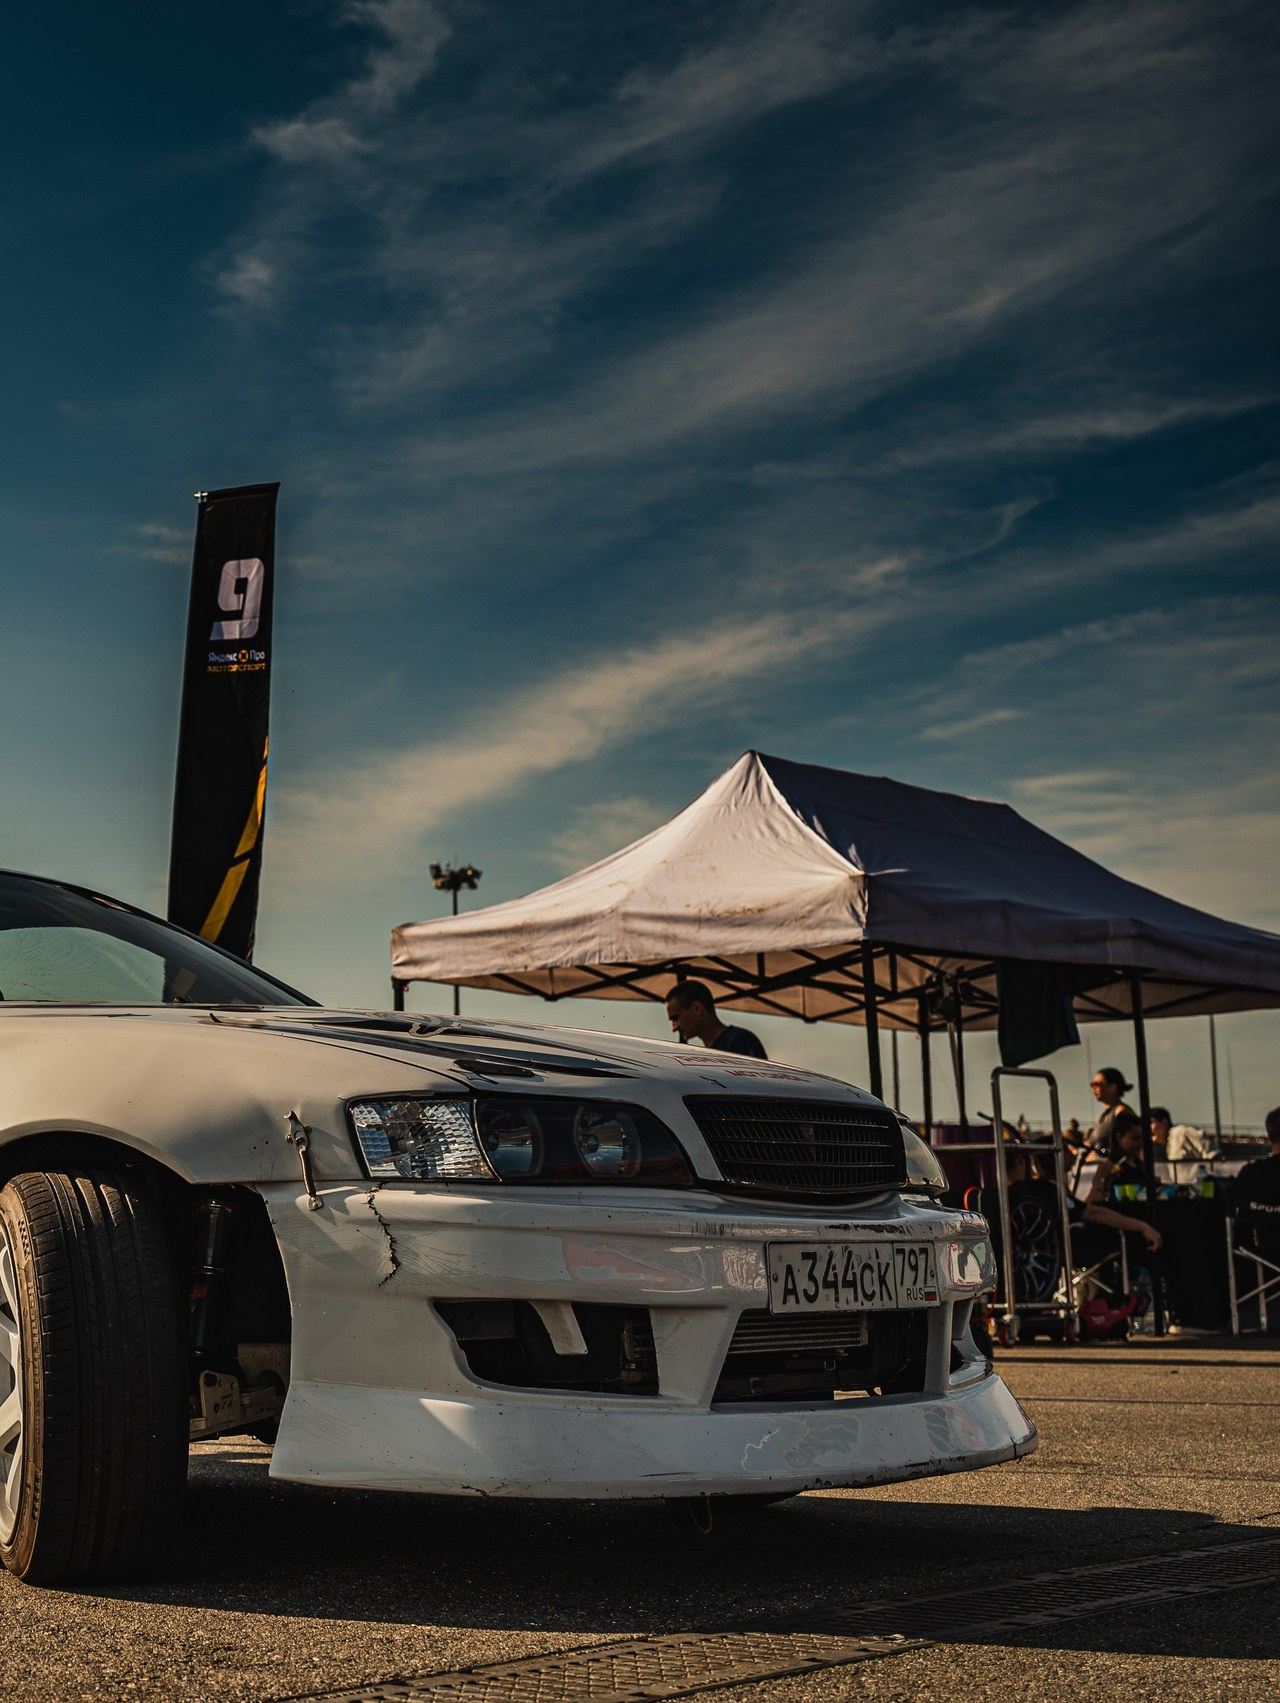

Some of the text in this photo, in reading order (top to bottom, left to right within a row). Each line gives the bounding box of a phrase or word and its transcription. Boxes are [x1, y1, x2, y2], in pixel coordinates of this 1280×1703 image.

[210, 558, 265, 641] 9
[208, 649, 266, 663] Яндекс Про
[895, 1247, 929, 1286] 797
[906, 1287, 924, 1301] RUS
